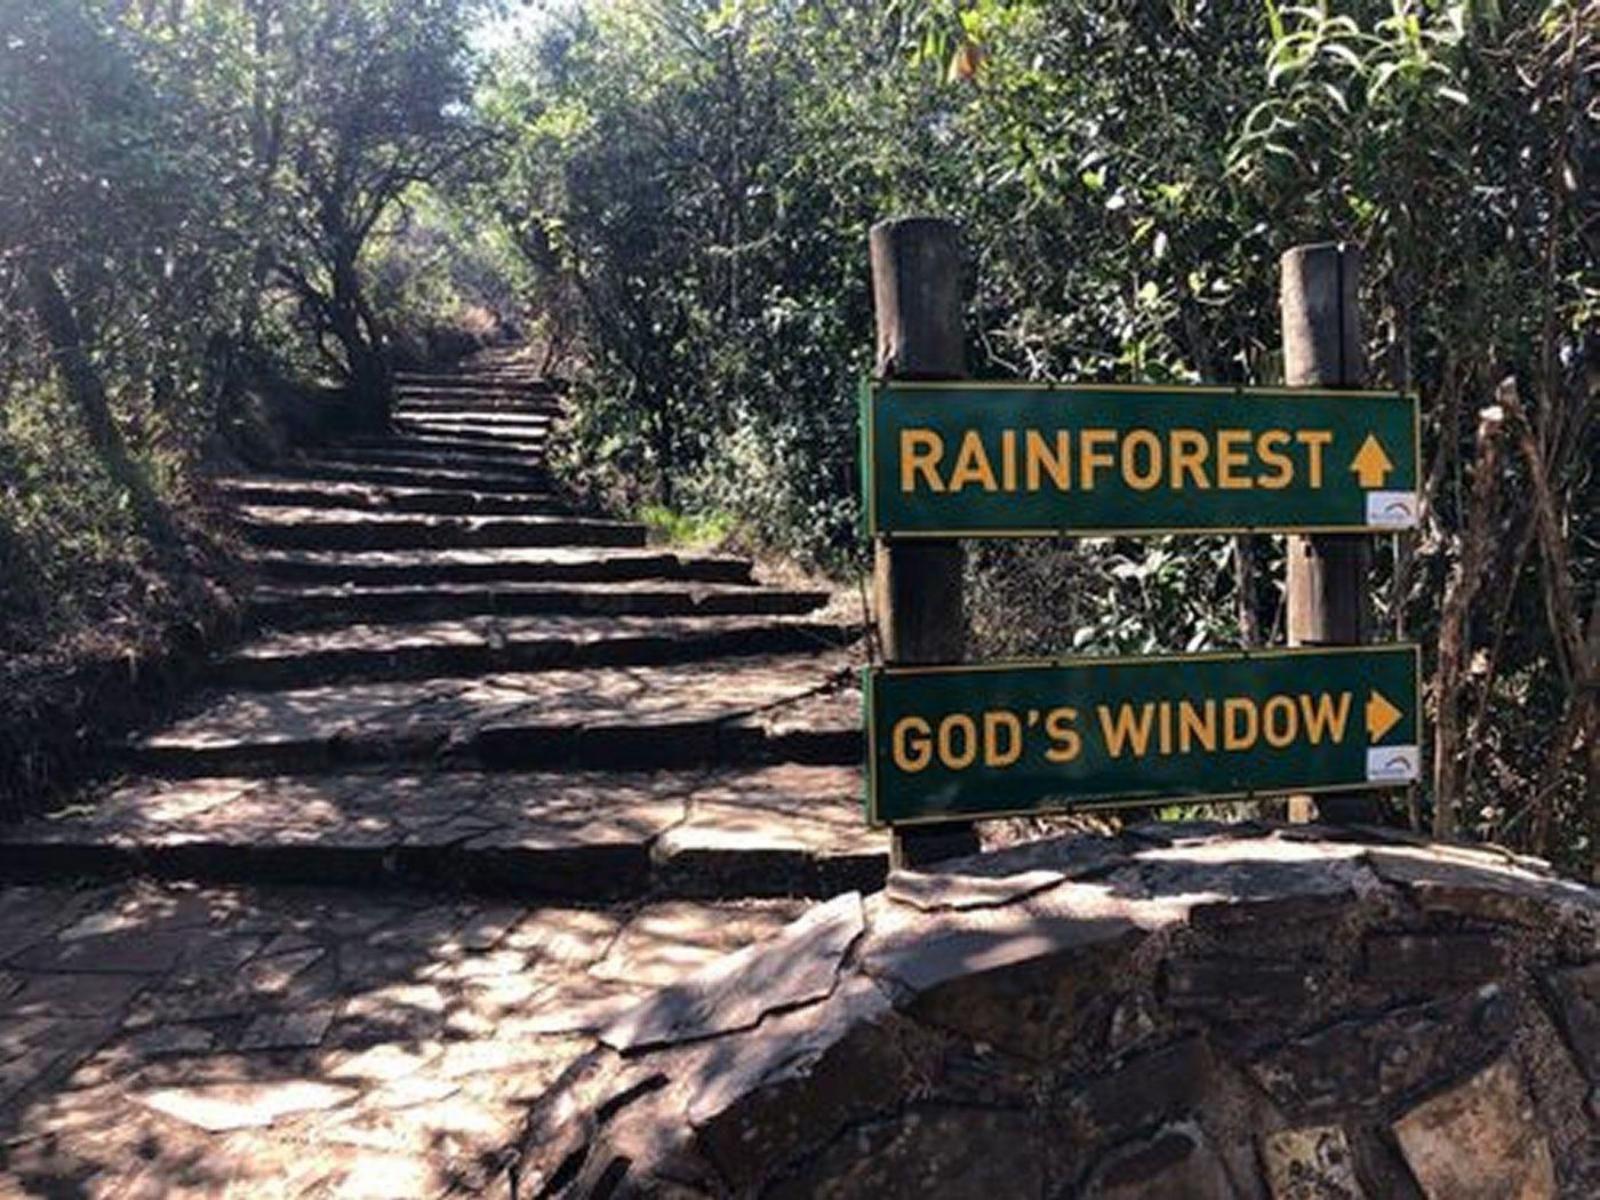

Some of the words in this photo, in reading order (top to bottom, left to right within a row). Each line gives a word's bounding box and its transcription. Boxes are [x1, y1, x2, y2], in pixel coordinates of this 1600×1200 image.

[900, 429, 1333, 492] RAINFOREST
[892, 707, 1081, 773] GOD'S
[1099, 692, 1351, 757] WINDOW
